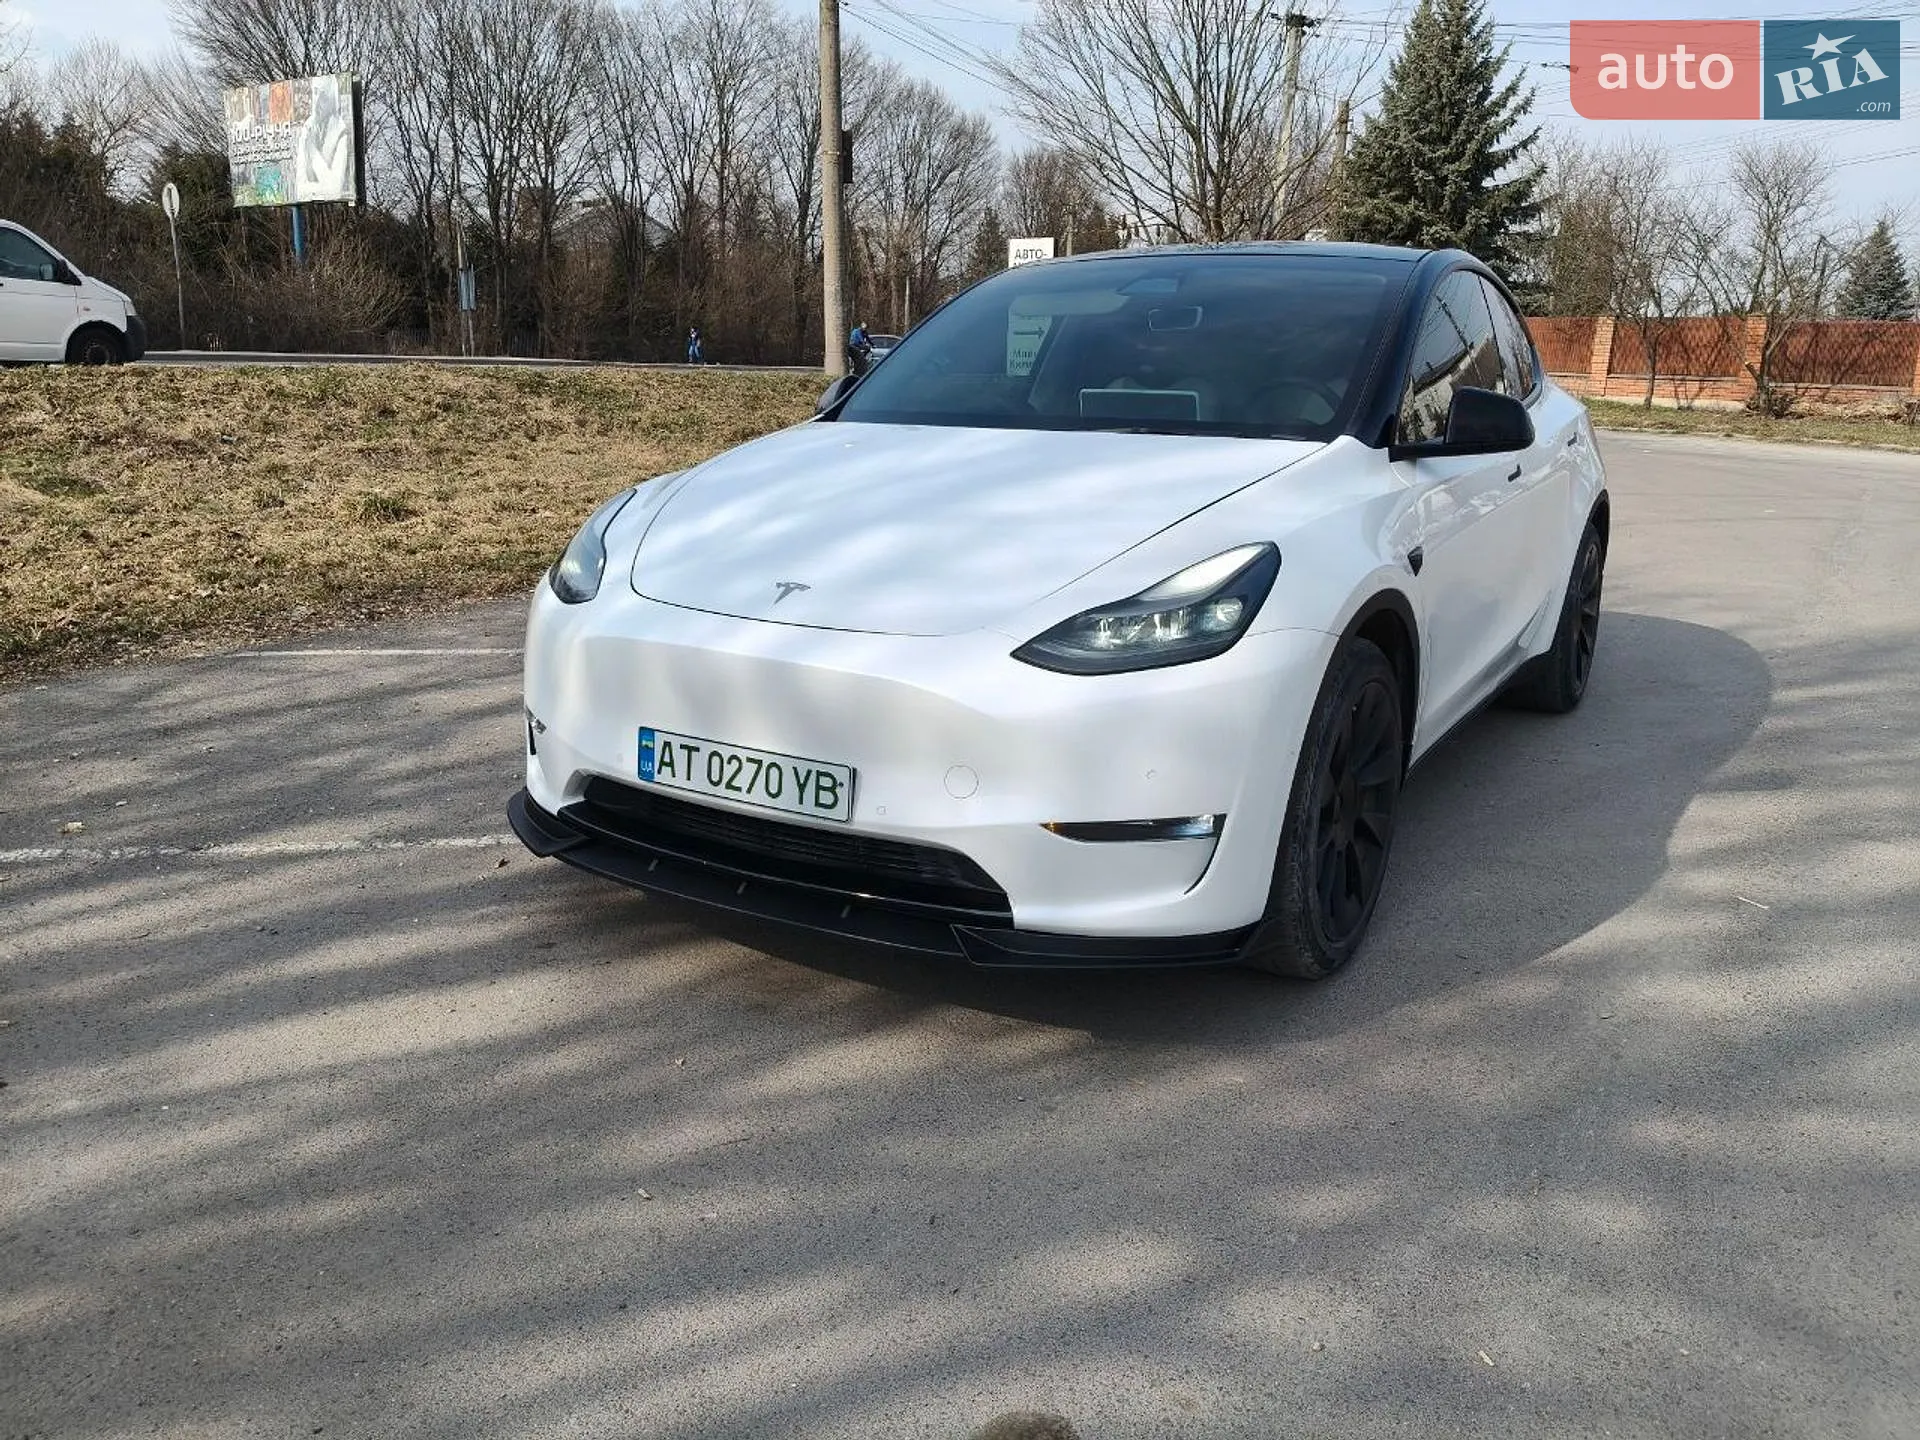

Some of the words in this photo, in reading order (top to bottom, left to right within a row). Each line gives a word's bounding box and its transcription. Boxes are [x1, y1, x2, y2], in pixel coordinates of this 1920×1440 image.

[657, 740, 700, 781] AT
[706, 750, 783, 799] 0270
[792, 766, 840, 810] YB
